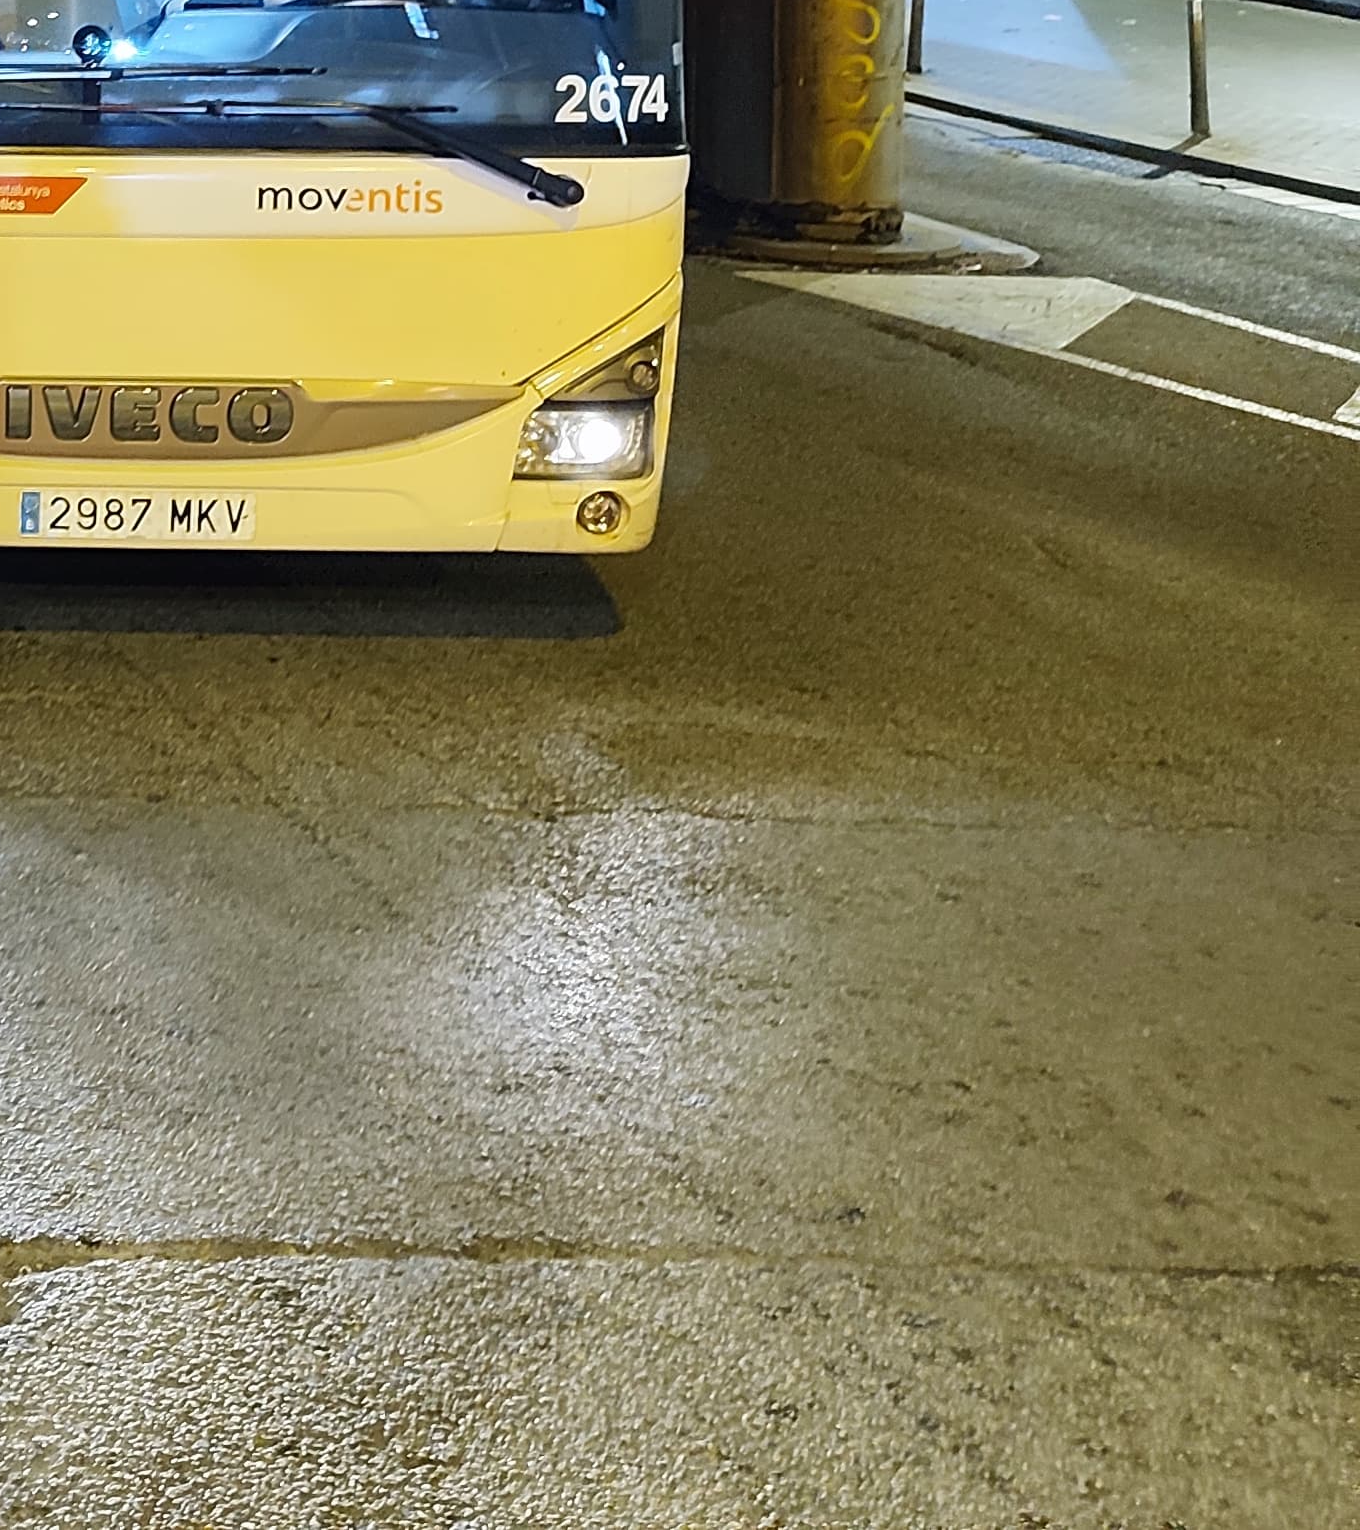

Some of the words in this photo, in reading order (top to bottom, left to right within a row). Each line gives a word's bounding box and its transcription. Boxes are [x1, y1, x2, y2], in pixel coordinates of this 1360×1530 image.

[554, 74, 669, 123] 2674
[257, 180, 444, 214] moventis
[5, 384, 295, 444] IVECO
[49, 497, 152, 532] 2987
[170, 499, 246, 533] MKV
